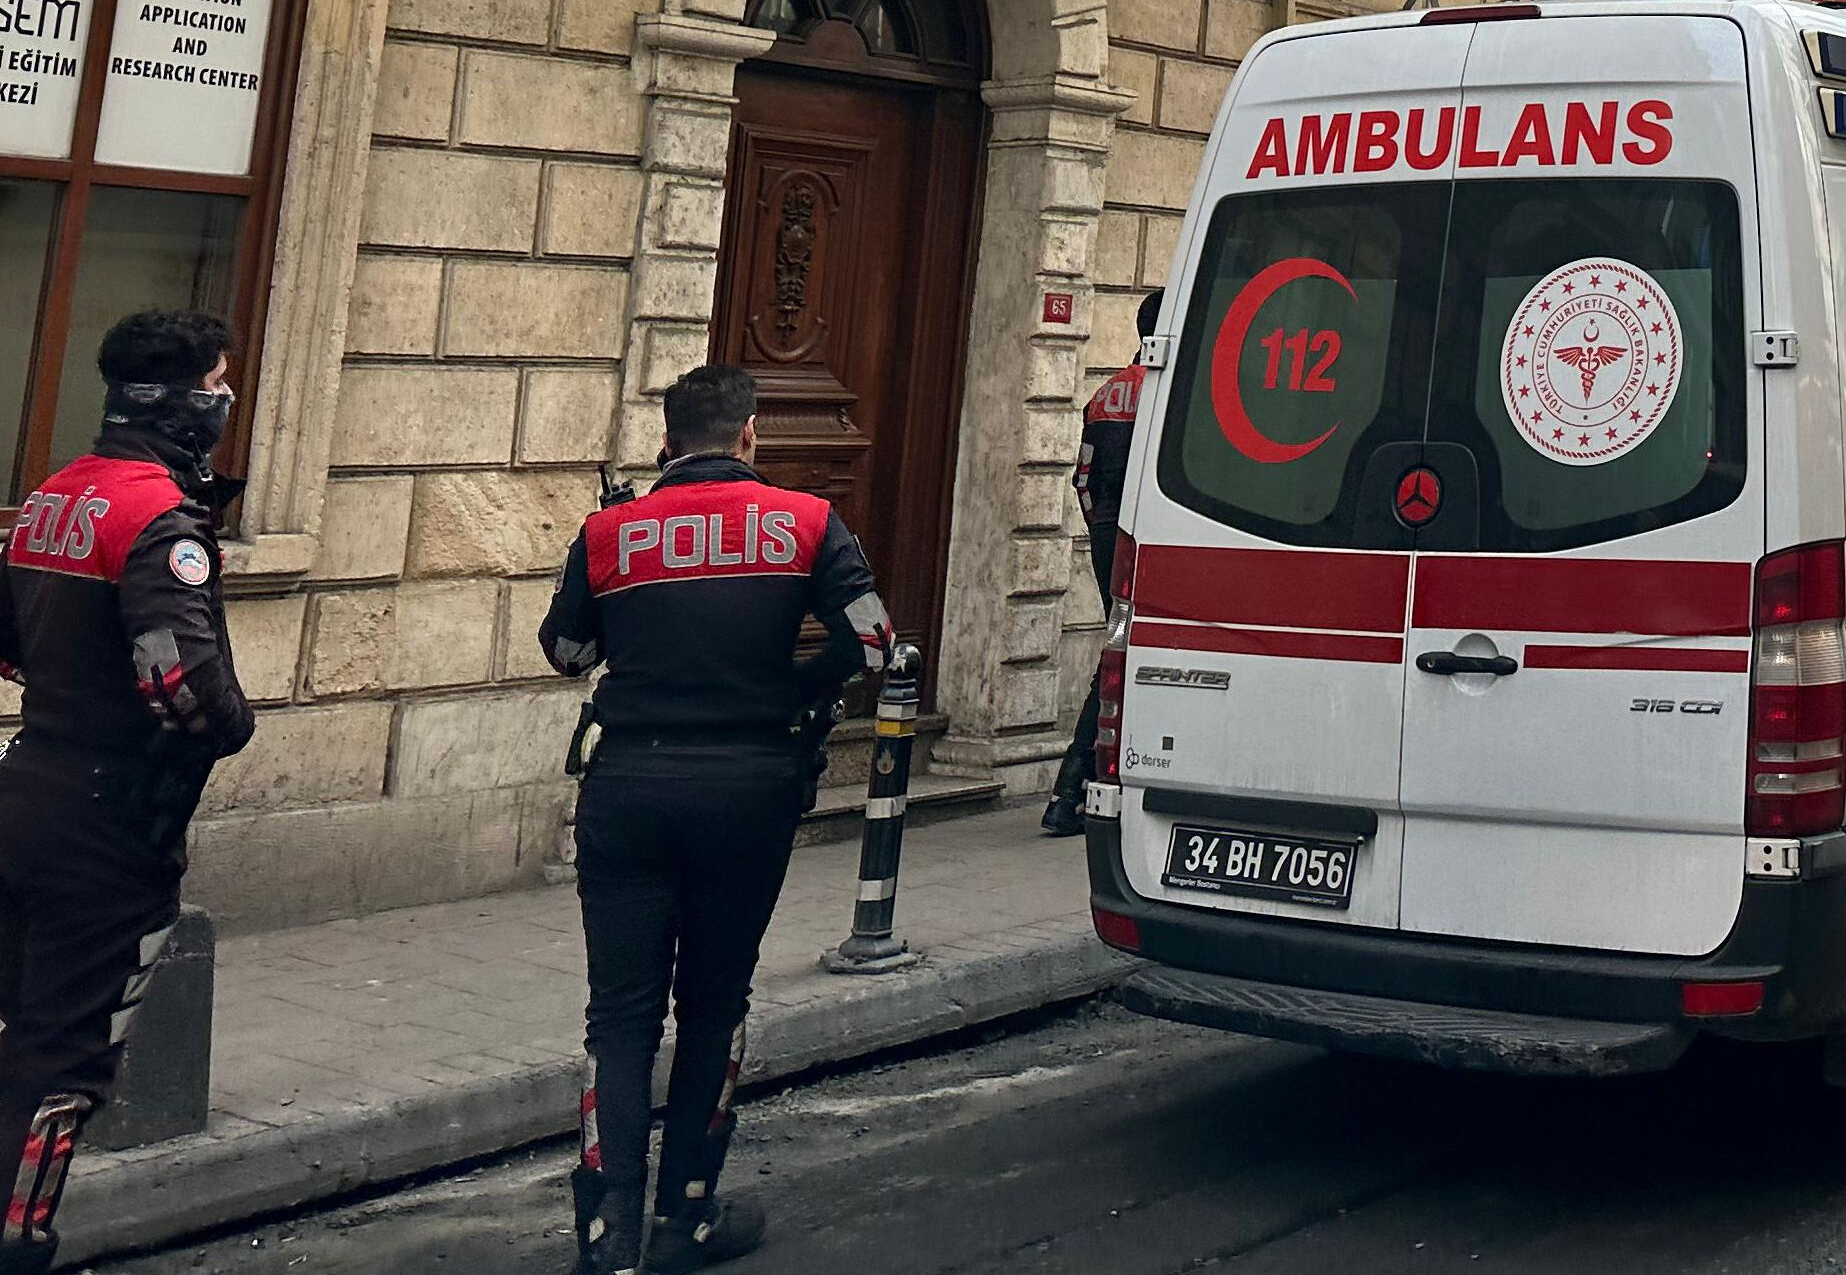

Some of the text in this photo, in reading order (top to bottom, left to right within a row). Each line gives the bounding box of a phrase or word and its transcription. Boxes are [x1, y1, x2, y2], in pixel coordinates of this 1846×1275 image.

[140, 5, 246, 34] APPLICATION
[9, 48, 77, 77] EĞİTİM
[172, 37, 207, 56] AND
[112, 57, 258, 90] RESEARCH CENTER
[1245, 99, 1673, 179] AMBULANS
[1052, 299, 1066, 315] 65
[1605, 301, 1641, 337] SAĞLIK
[1261, 329, 1343, 393] 112
[1612, 339, 1645, 412] BAKANLIĞI
[10, 486, 110, 559] POLİS
[618, 503, 797, 575] POLİS
[1185, 835, 1346, 889] 34 BH 7056
